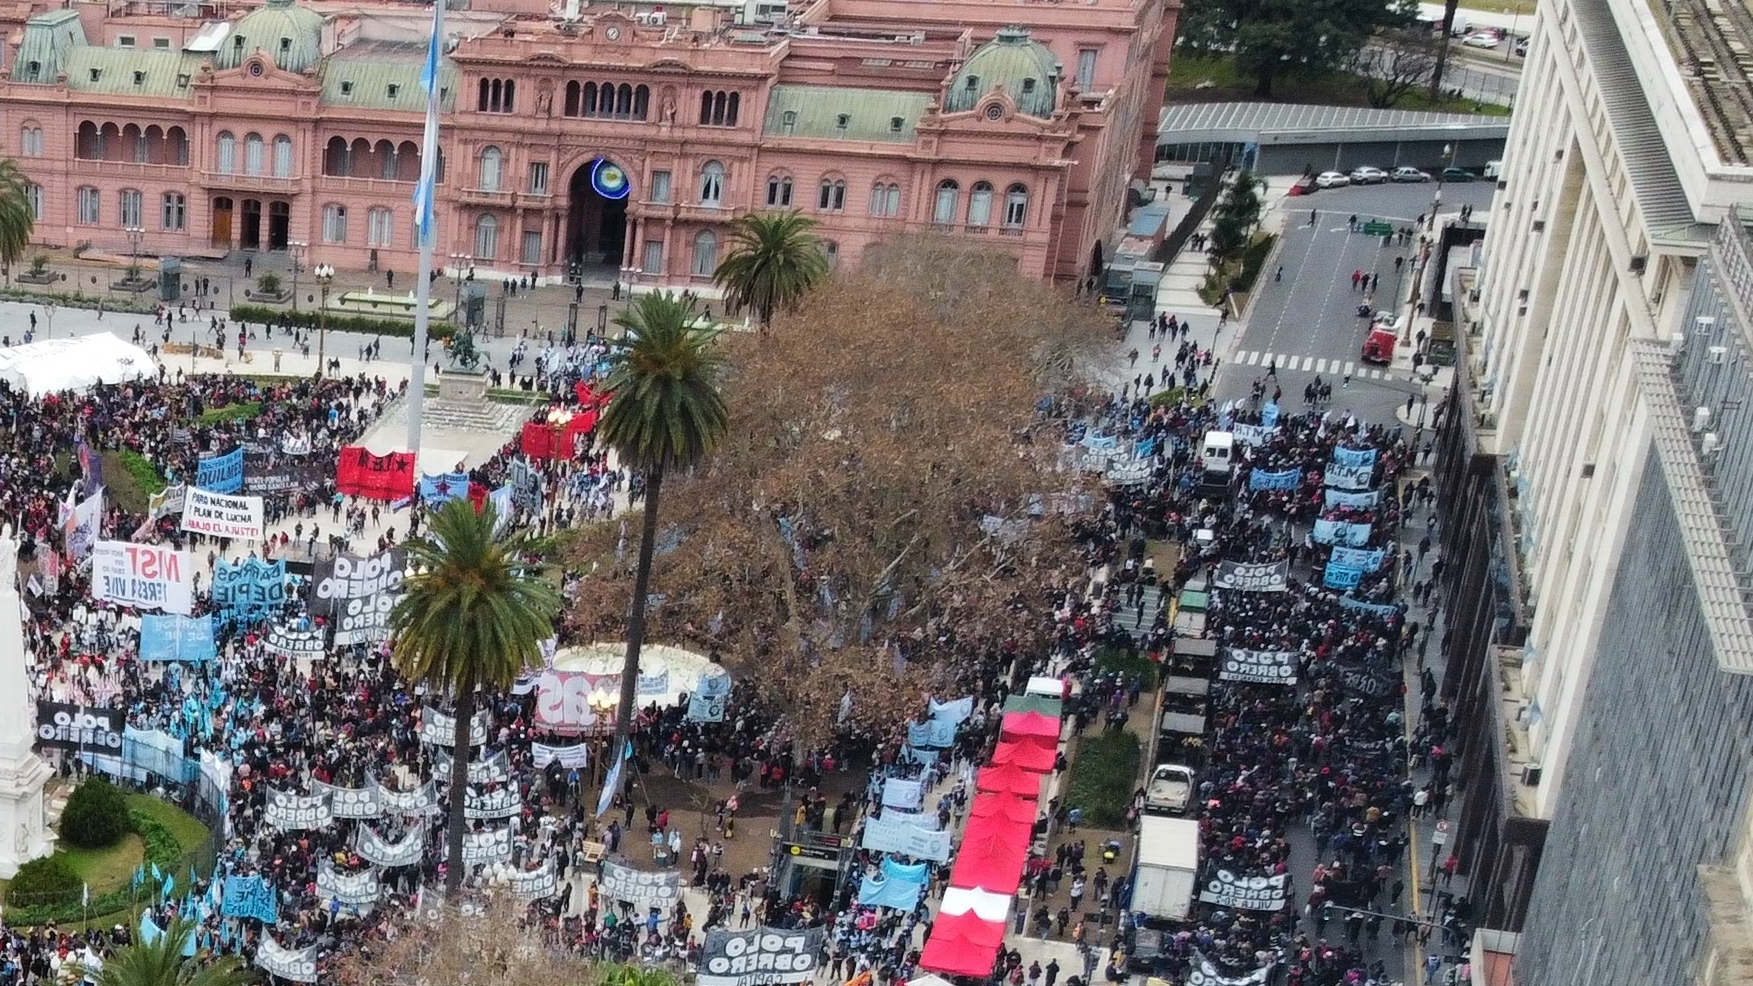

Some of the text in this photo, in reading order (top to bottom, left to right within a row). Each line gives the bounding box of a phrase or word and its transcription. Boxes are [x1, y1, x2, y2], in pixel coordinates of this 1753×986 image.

[199, 464, 242, 486] QUILMES
[192, 492, 249, 511] PARO NACIONAL
[194, 507, 212, 520] PLAN
[214, 511, 224, 521] DE
[226, 511, 252, 524] LUCHA
